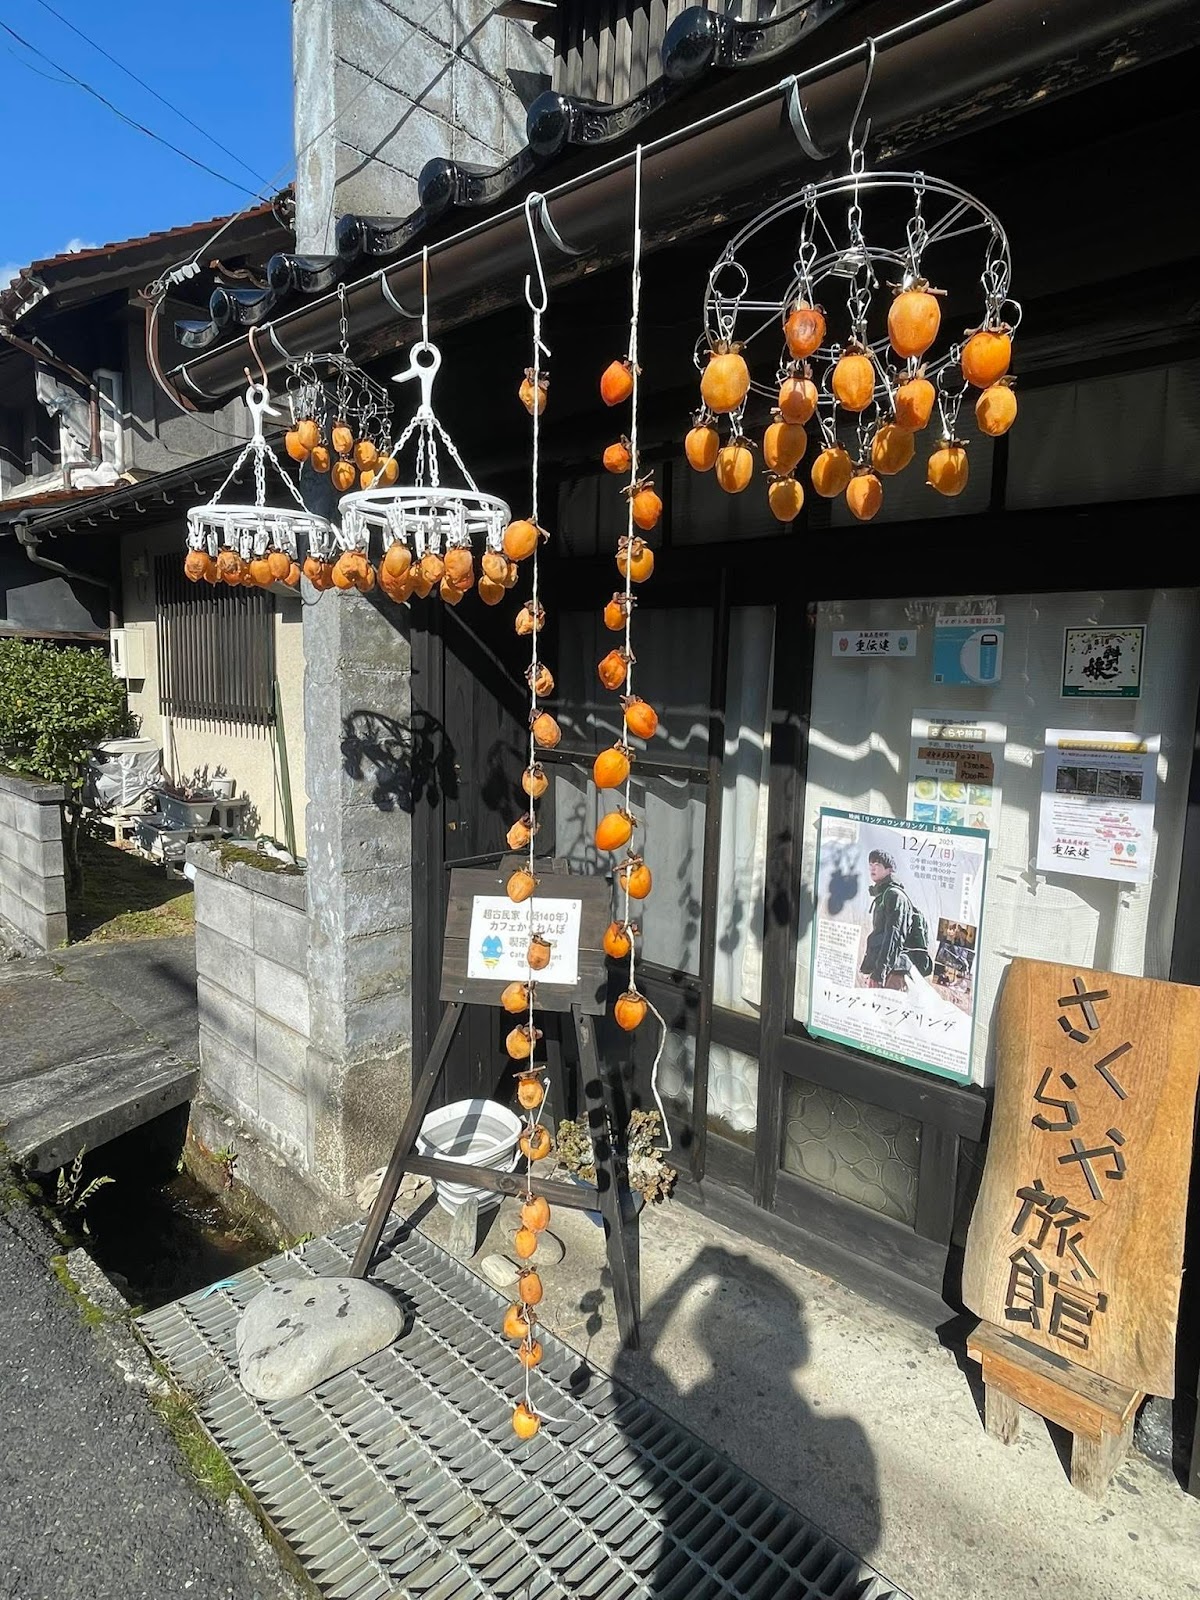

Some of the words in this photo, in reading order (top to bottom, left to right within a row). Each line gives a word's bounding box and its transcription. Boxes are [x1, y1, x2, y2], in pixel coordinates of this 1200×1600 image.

[855, 638, 890, 652] 重伝建
[931, 728, 983, 740] さくらや旅館
[1051, 843, 1090, 859] 重伝建
[1004, 976, 1133, 1350] さくらや旅館
